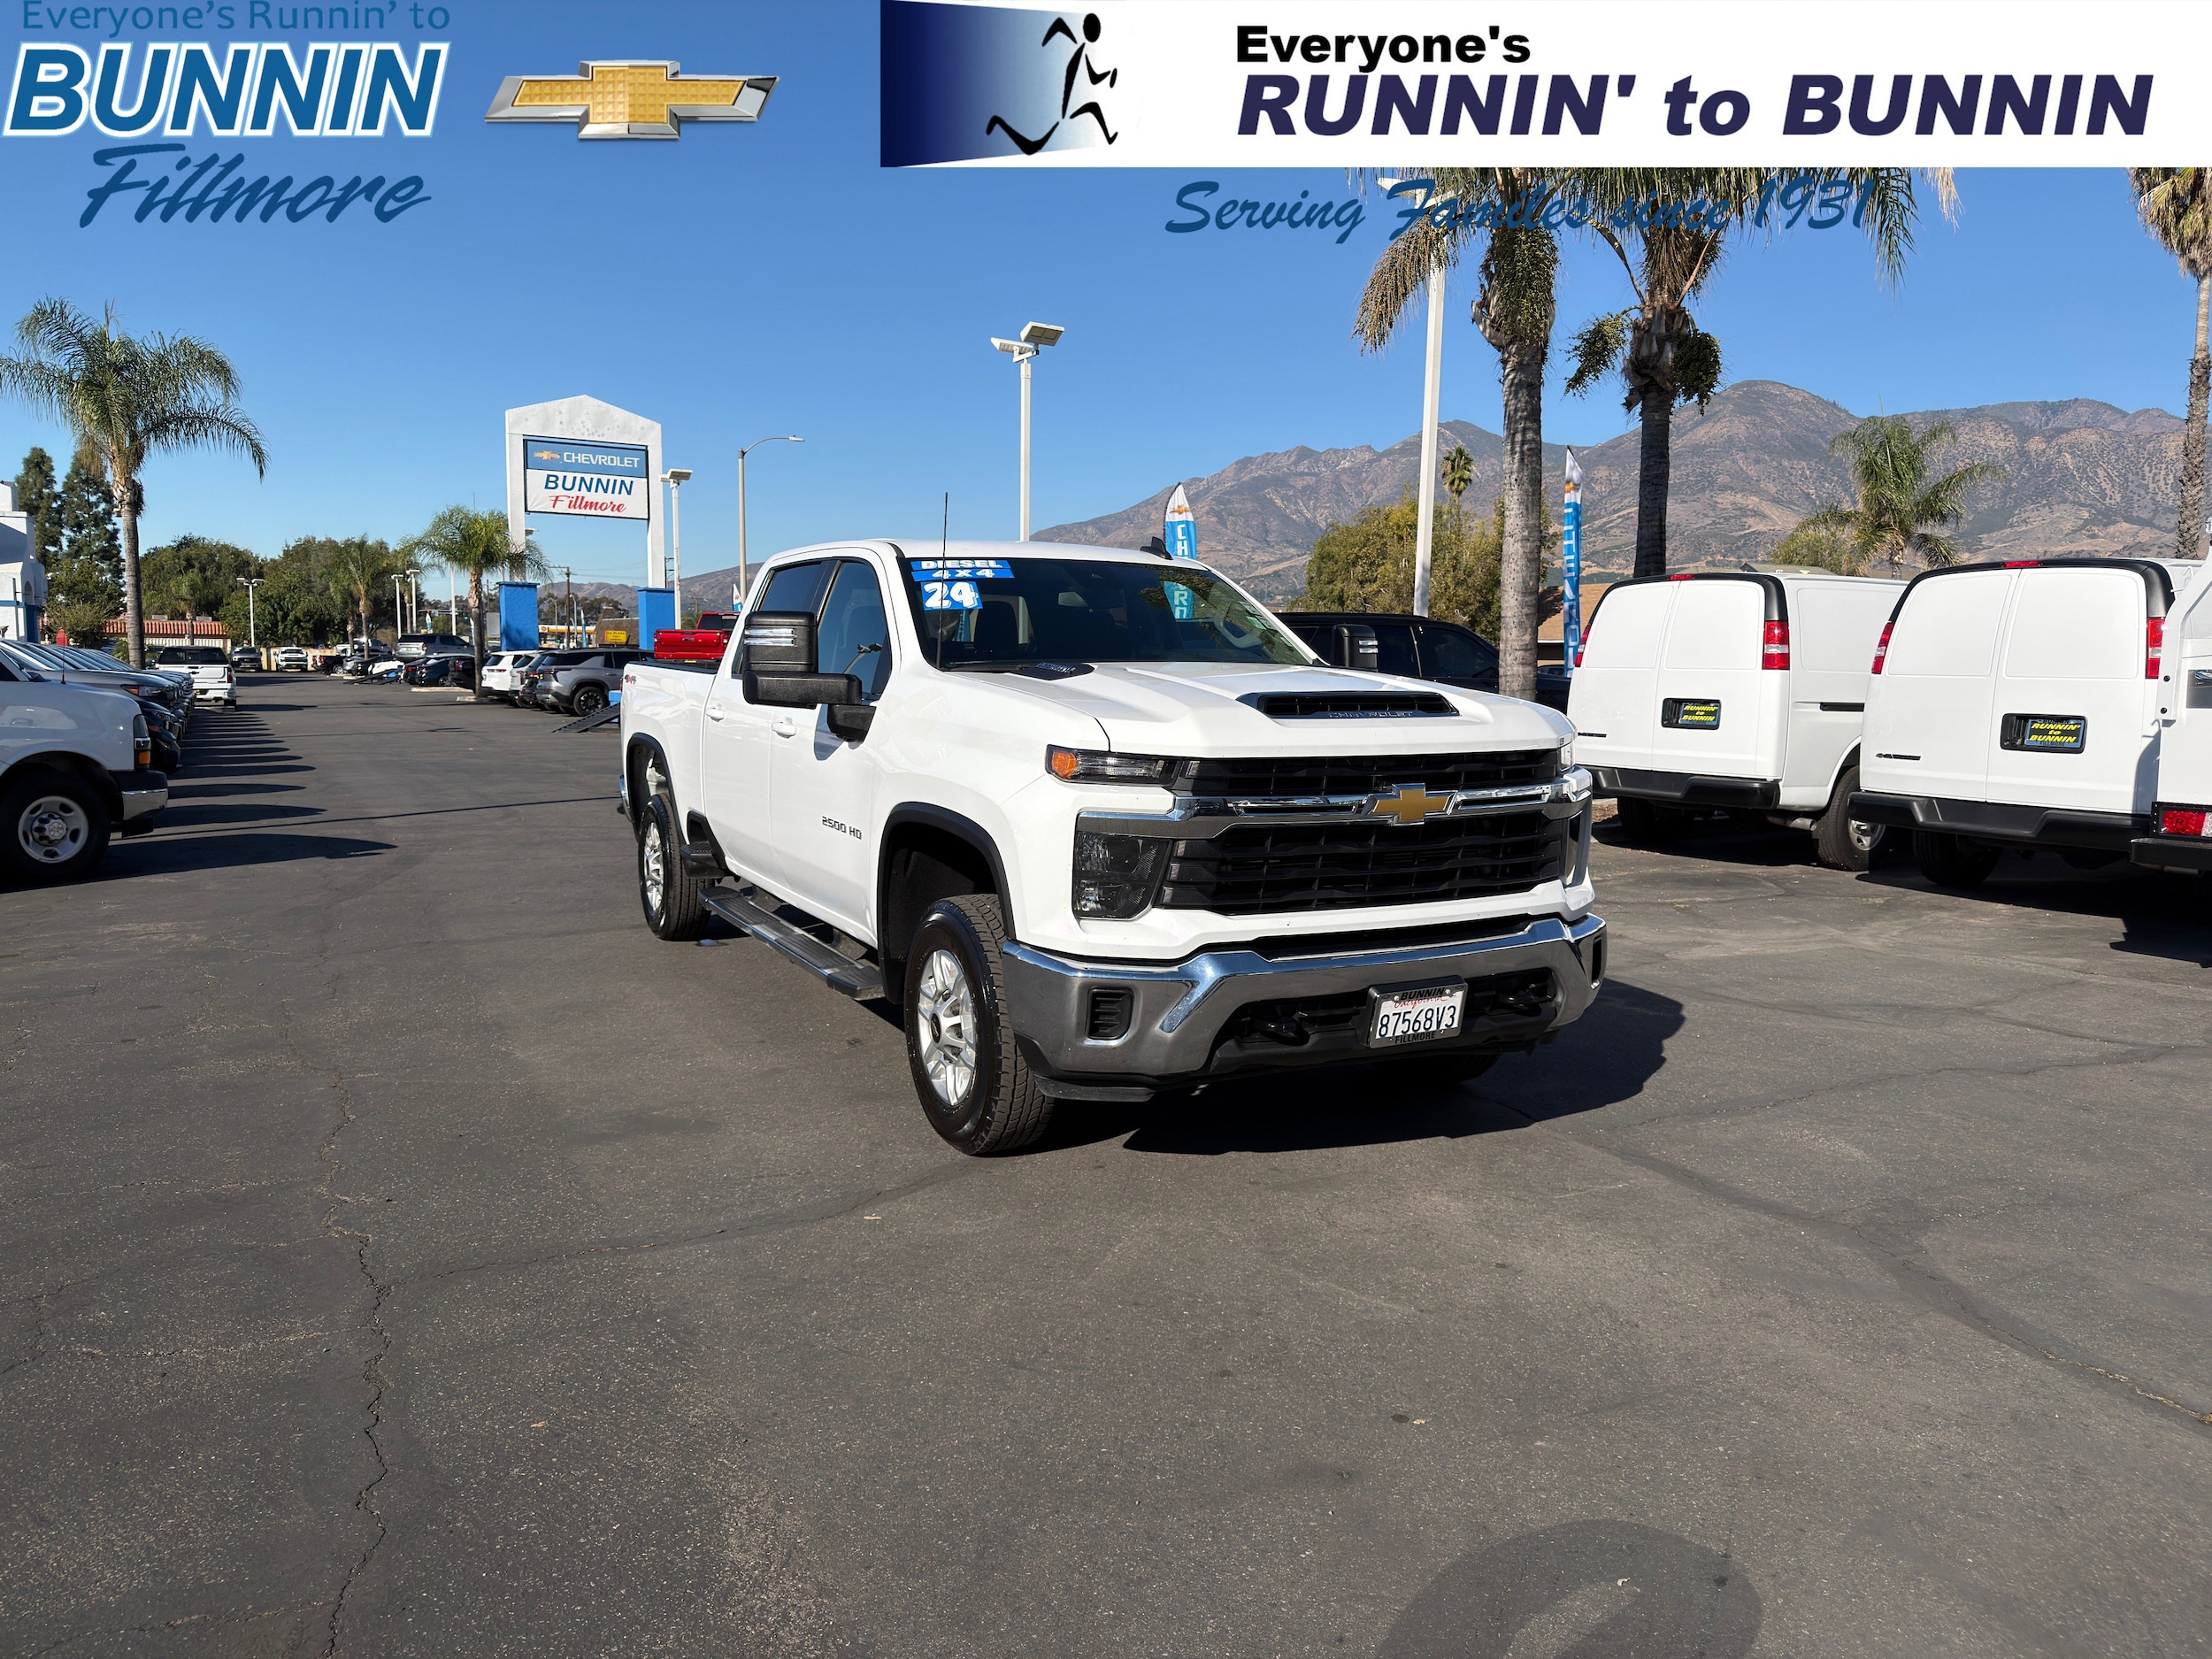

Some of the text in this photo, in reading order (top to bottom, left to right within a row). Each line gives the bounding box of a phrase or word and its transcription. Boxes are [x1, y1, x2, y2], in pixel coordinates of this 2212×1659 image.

[564, 452, 640, 468] CHEVROLET
[544, 474, 634, 495] BUNNIN
[549, 495, 626, 513] Fillmore
[921, 560, 1003, 570] DIESEL
[923, 581, 979, 608] 24
[2030, 734, 2077, 743] BUNNIN
[821, 816, 863, 841] 2500 HD
[1401, 987, 1445, 1001] BUNNIN
[1379, 1005, 1456, 1038] 87568V3
[1395, 1031, 1436, 1044] FILLMORE
